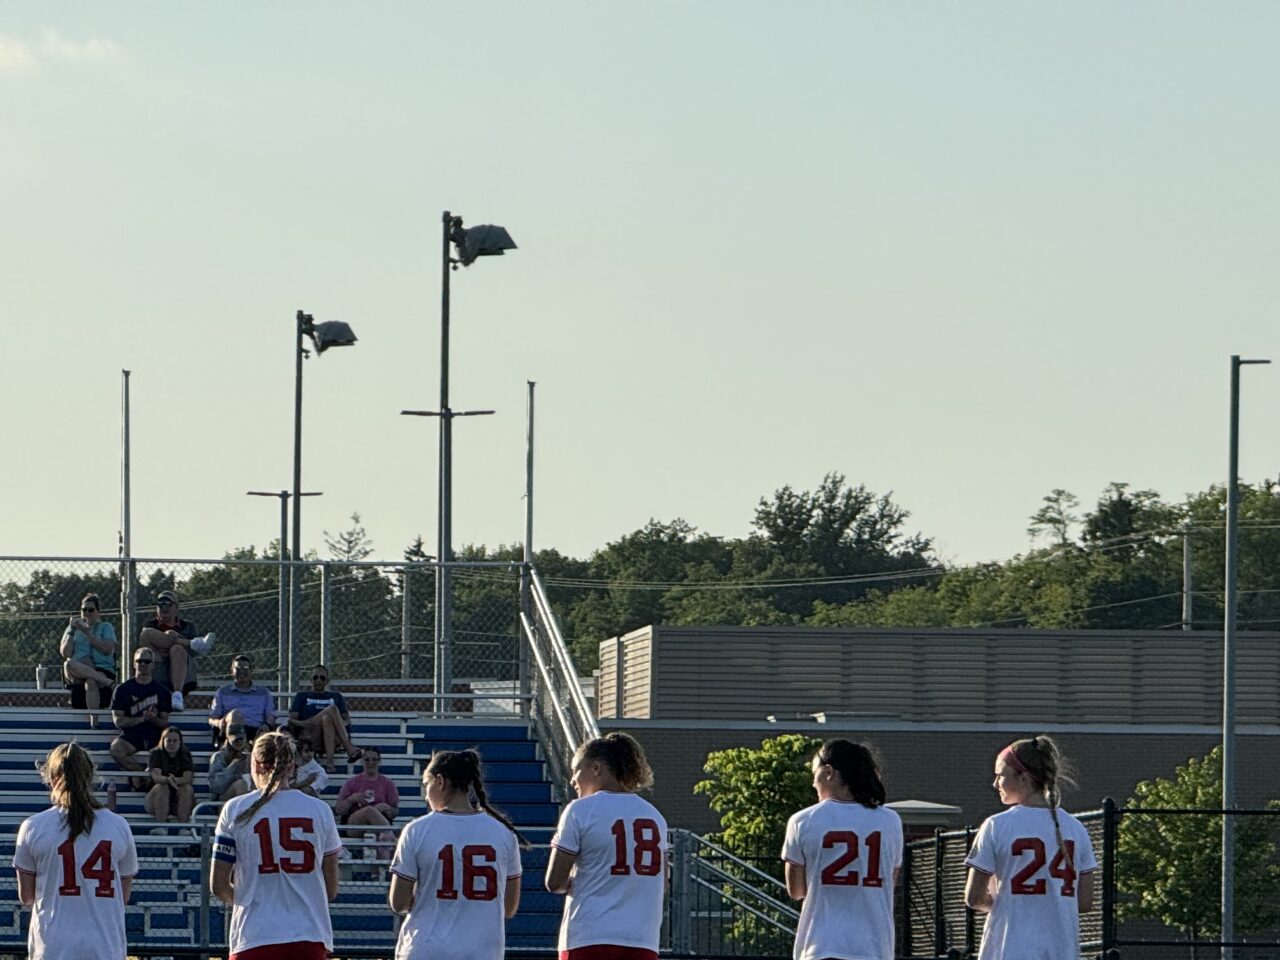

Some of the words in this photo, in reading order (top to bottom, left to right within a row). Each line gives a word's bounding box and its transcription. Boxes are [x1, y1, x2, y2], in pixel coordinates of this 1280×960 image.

[57, 838, 115, 898] 14
[253, 817, 316, 875] 15
[436, 844, 498, 901] 16
[610, 818, 662, 877] 18
[821, 830, 883, 889] 21
[1011, 837, 1077, 897] 24
